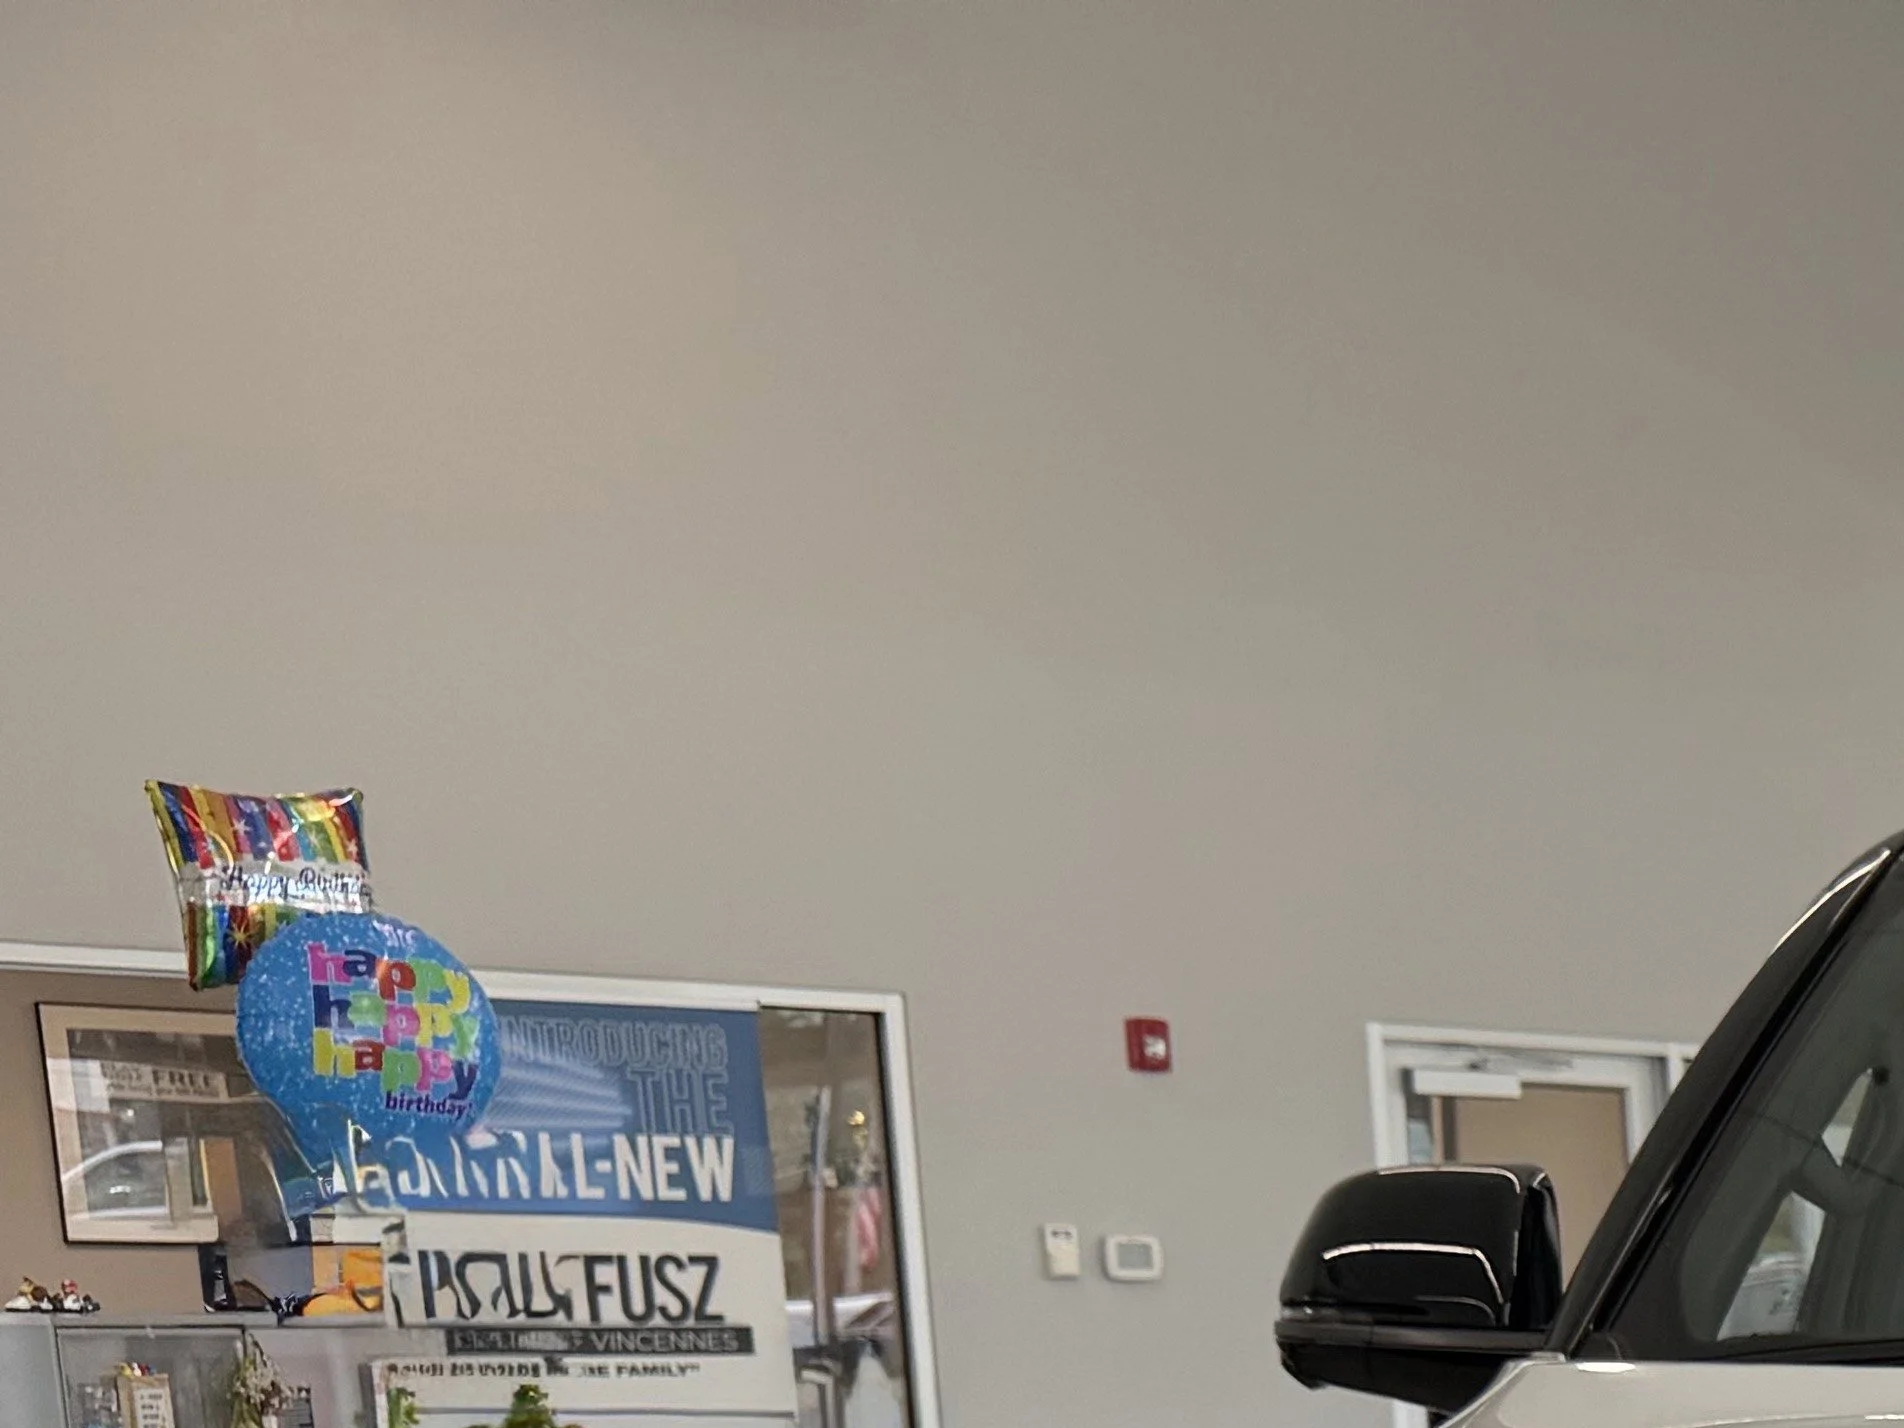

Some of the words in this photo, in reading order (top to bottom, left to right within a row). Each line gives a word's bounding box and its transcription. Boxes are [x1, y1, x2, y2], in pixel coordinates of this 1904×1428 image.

[307, 940, 471, 1014] happy
[312, 1027, 478, 1100] happy
[501, 1015, 729, 1070] NTRODUCING
[627, 1069, 735, 1137] THE
[583, 1253, 725, 1323] FUSZ
[591, 1331, 740, 1353] VINCENNES
